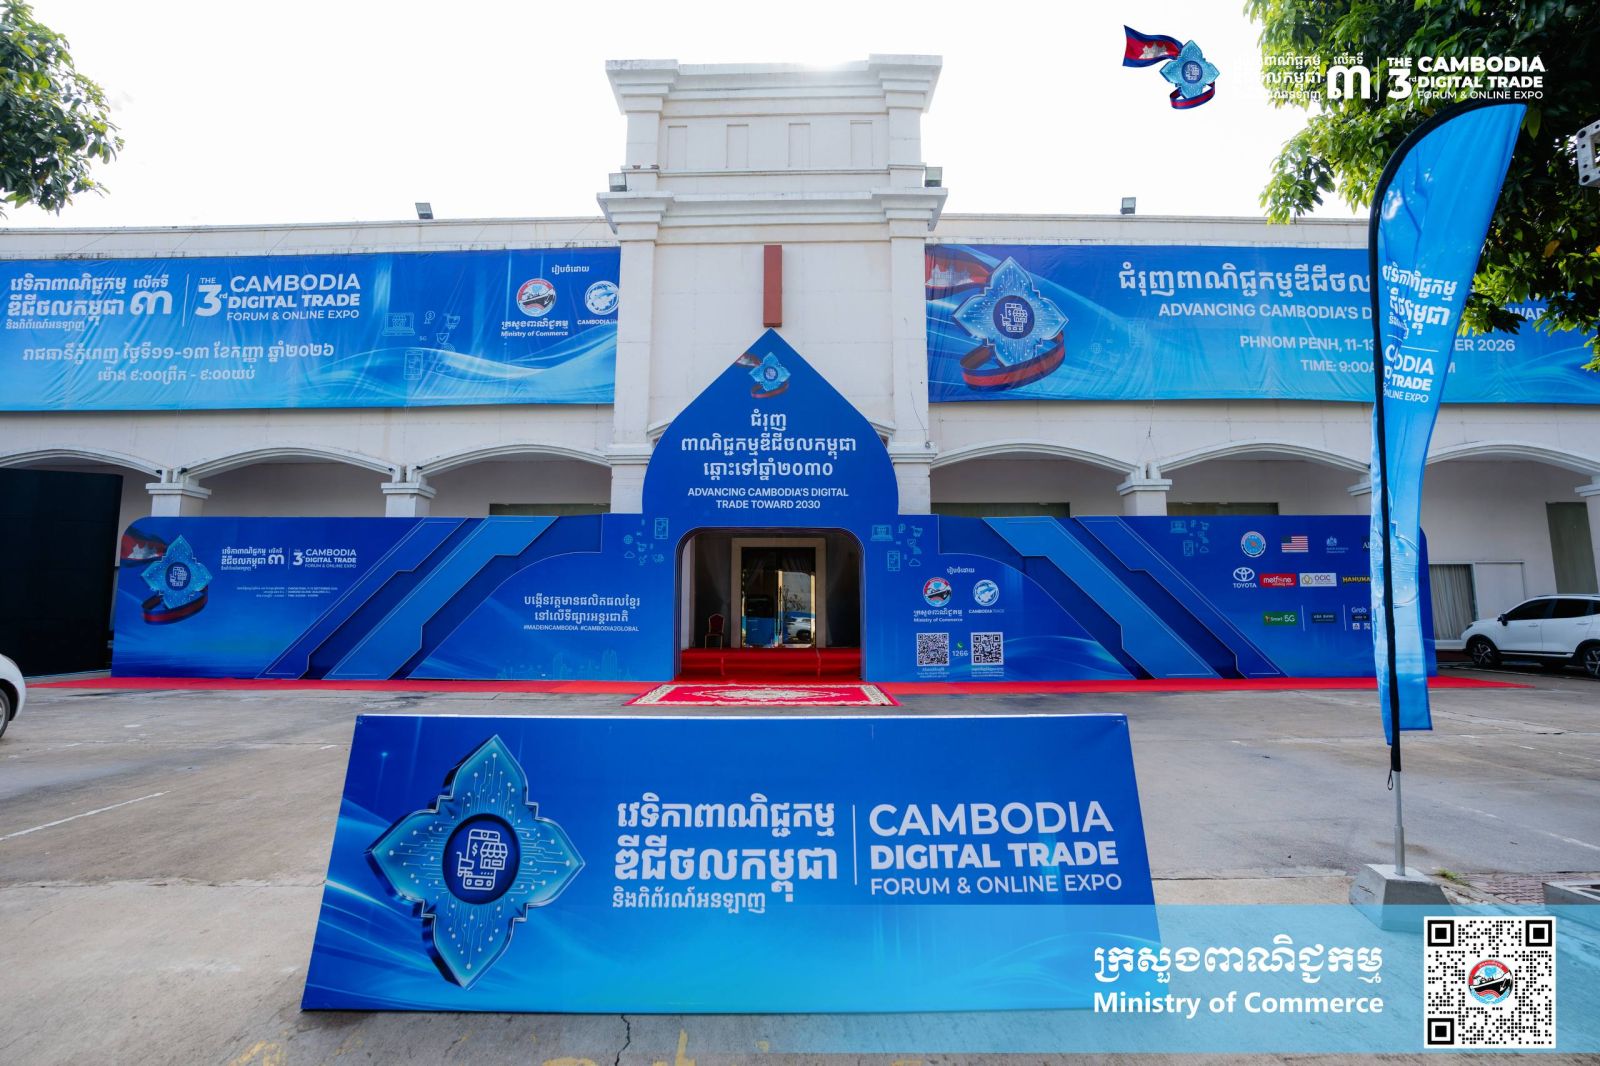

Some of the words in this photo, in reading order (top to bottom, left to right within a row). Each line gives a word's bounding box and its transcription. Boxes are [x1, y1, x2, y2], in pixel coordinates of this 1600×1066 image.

[11, 273, 126, 295] វេទិកាពាណិជ្ជកម្ម
[134, 274, 169, 289] លើកទី
[230, 273, 361, 293] CAMBODIA
[7, 294, 125, 325] ឌីជីថលកម្ពុជា
[130, 290, 173, 315] ៣
[228, 295, 297, 309] DIGITAL
[301, 294, 361, 307] TRADE
[227, 312, 269, 321] FORUM
[271, 312, 280, 321] &
[282, 311, 324, 320] ONLINE
[328, 310, 359, 319] EXPO
[1159, 303, 1256, 317] ADVANCING
[1259, 304, 1358, 320] CAMBODIA'S
[501, 330, 526, 338] Ministry
[1240, 335, 1296, 349] PHNOM
[1300, 337, 1342, 353] PENH,
[1477, 339, 1516, 352] 2026
[1300, 359, 1337, 372] TIME:
[1392, 374, 1432, 391] TRADE
[1404, 392, 1429, 403] EXPO
[751, 409, 787, 431] ជំរុញ
[681, 433, 856, 459] ពាណិជ្ជកម្មឌីជីថលកម្ពុជា
[687, 488, 746, 497] ADVANCING
[748, 488, 809, 497] CAMBODIA'S
[811, 488, 849, 497] DIGITAL
[716, 500, 749, 509] TRADE
[751, 500, 794, 509] TOWARD
[795, 500, 821, 509] 2030
[306, 549, 357, 557] CAMBODIA
[1284, 614, 1295, 622] 5G
[617, 792, 835, 838] វេទិកាពាណិជ្ជកម្ម
[869, 800, 1114, 837] CAMBODIA
[870, 842, 1001, 870] DIGITAL
[1008, 841, 1119, 867] TRADE
[614, 835, 838, 903] ឌីជីថលកម្ពុជា
[870, 877, 951, 896] FORUM
[956, 877, 971, 895] &
[975, 875, 1059, 894] ONLINE
[1064, 873, 1122, 892] EXPO
